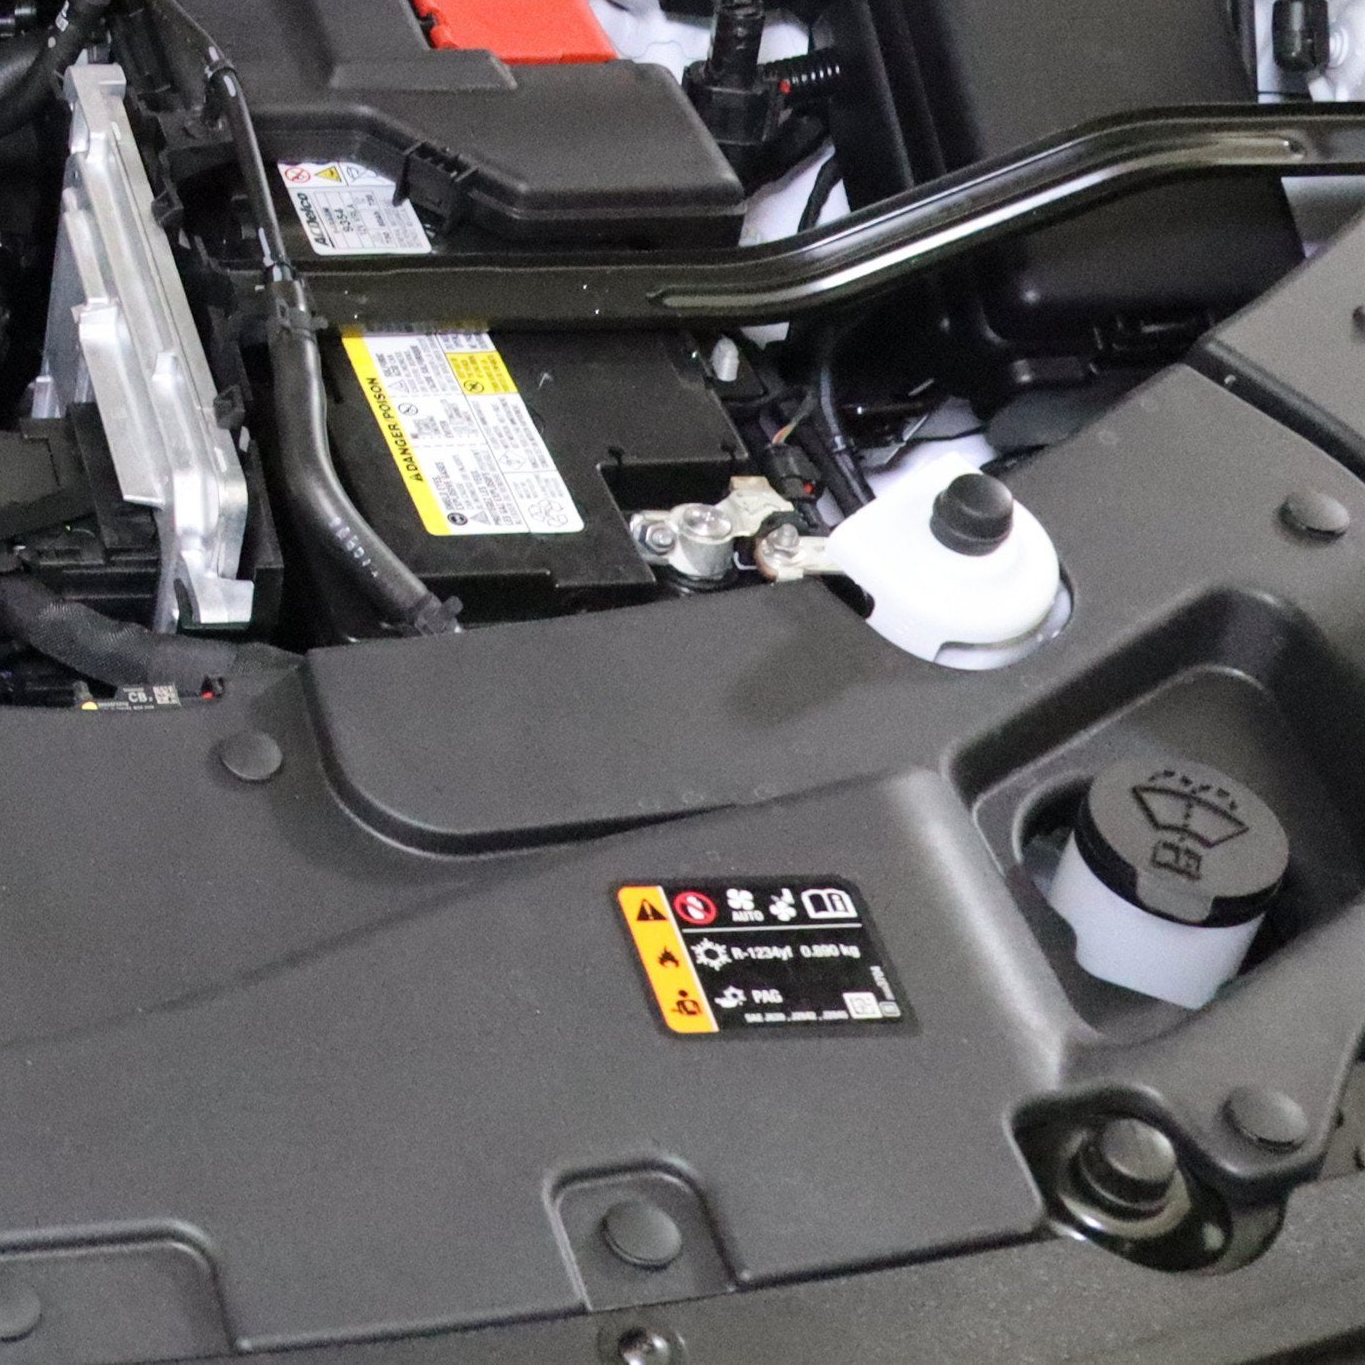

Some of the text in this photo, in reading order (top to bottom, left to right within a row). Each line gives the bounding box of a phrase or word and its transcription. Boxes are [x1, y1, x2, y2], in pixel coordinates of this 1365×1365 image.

[297, 192, 329, 247] ACDelco
[732, 910, 764, 922] AUTO
[731, 945, 793, 961] R-1234yf
[752, 989, 783, 1004] PAG
